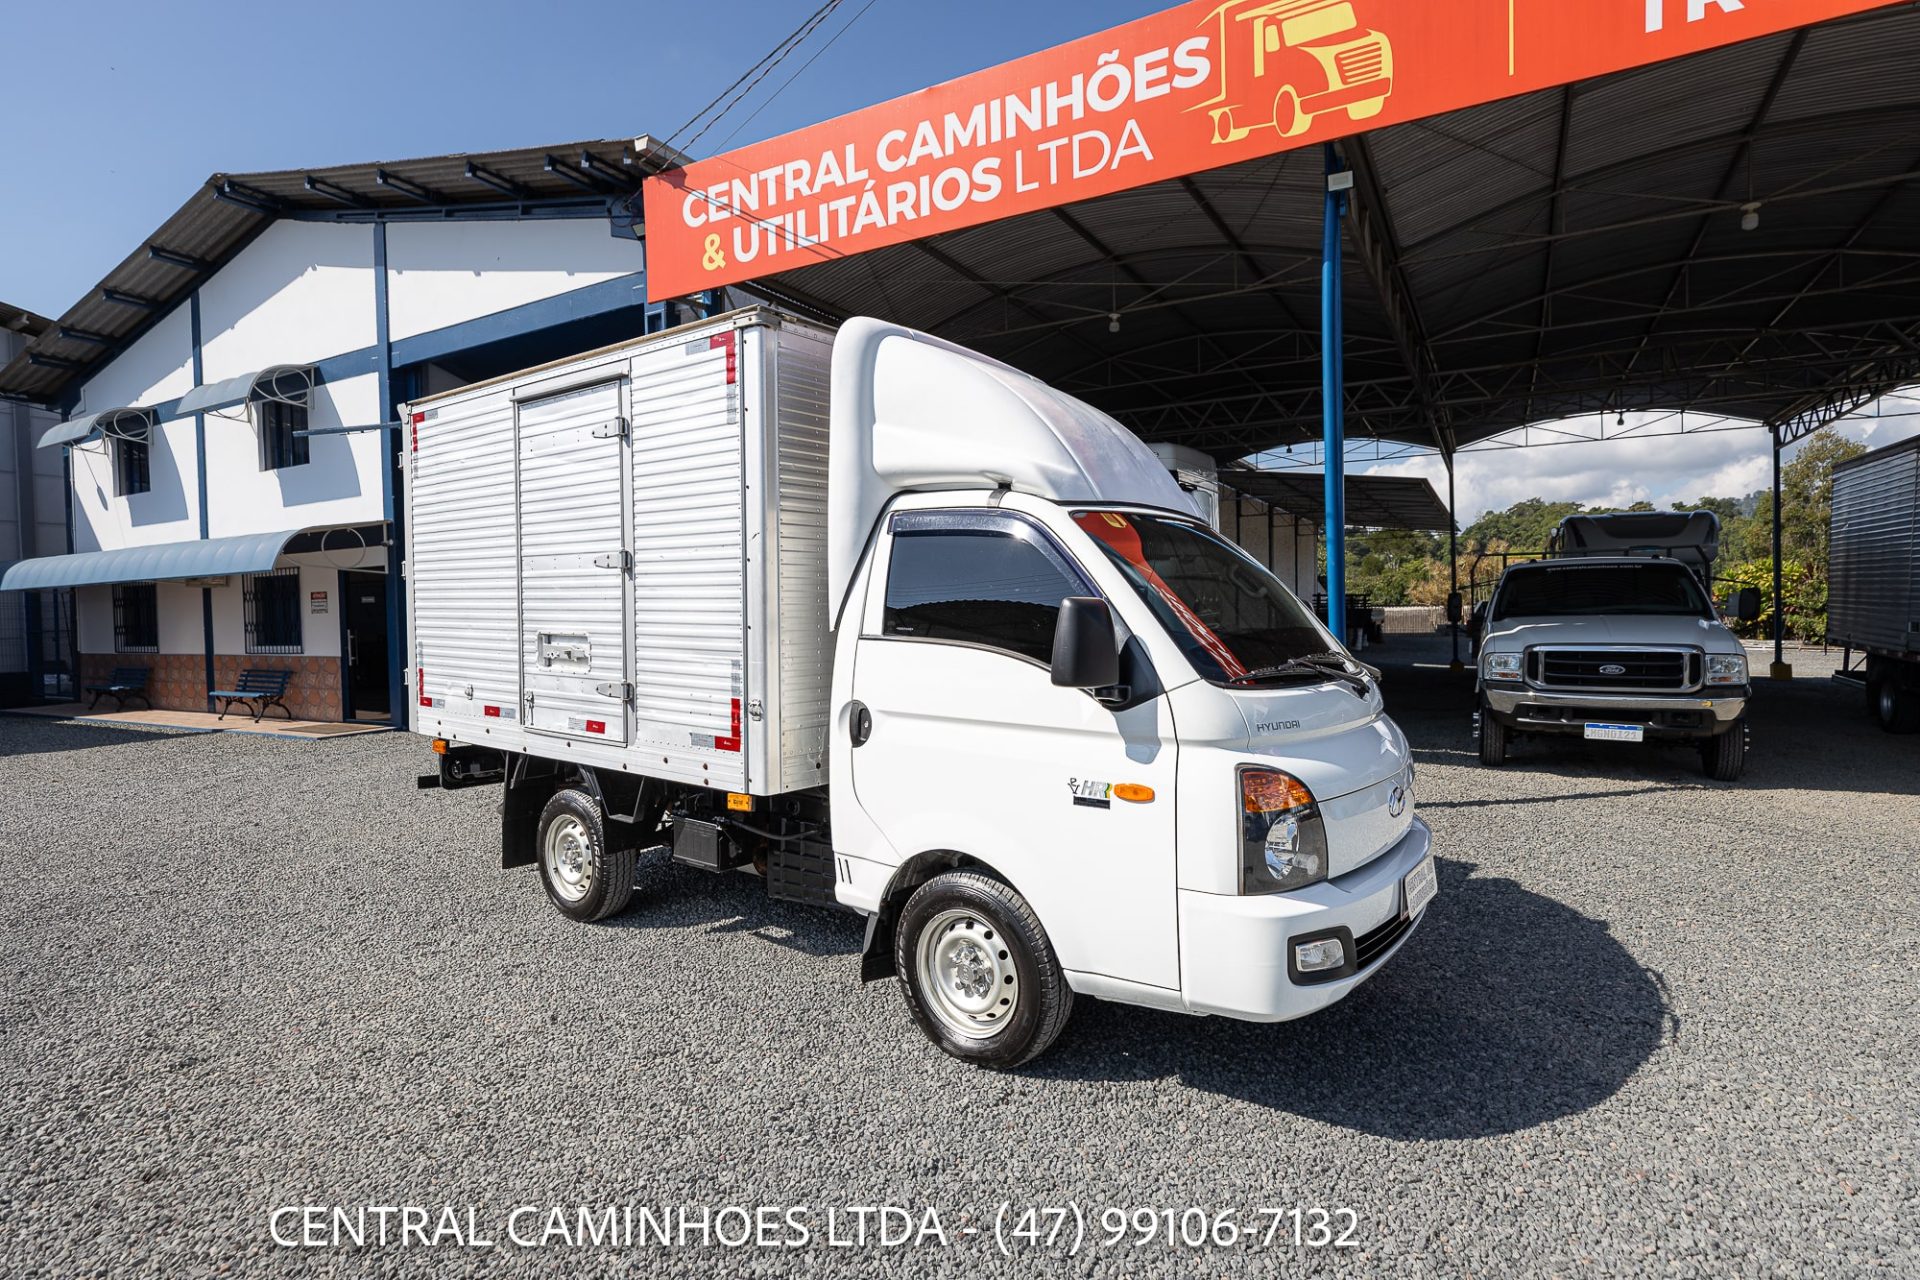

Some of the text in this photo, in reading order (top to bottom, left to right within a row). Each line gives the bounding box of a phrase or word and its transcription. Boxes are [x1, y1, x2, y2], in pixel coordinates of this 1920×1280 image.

[682, 35, 1211, 229] CENTRAL CAMINHÕES
[701, 119, 1154, 271] & UTILITÁRIOS LTDA
[1256, 720, 1301, 732] HYUNDAI
